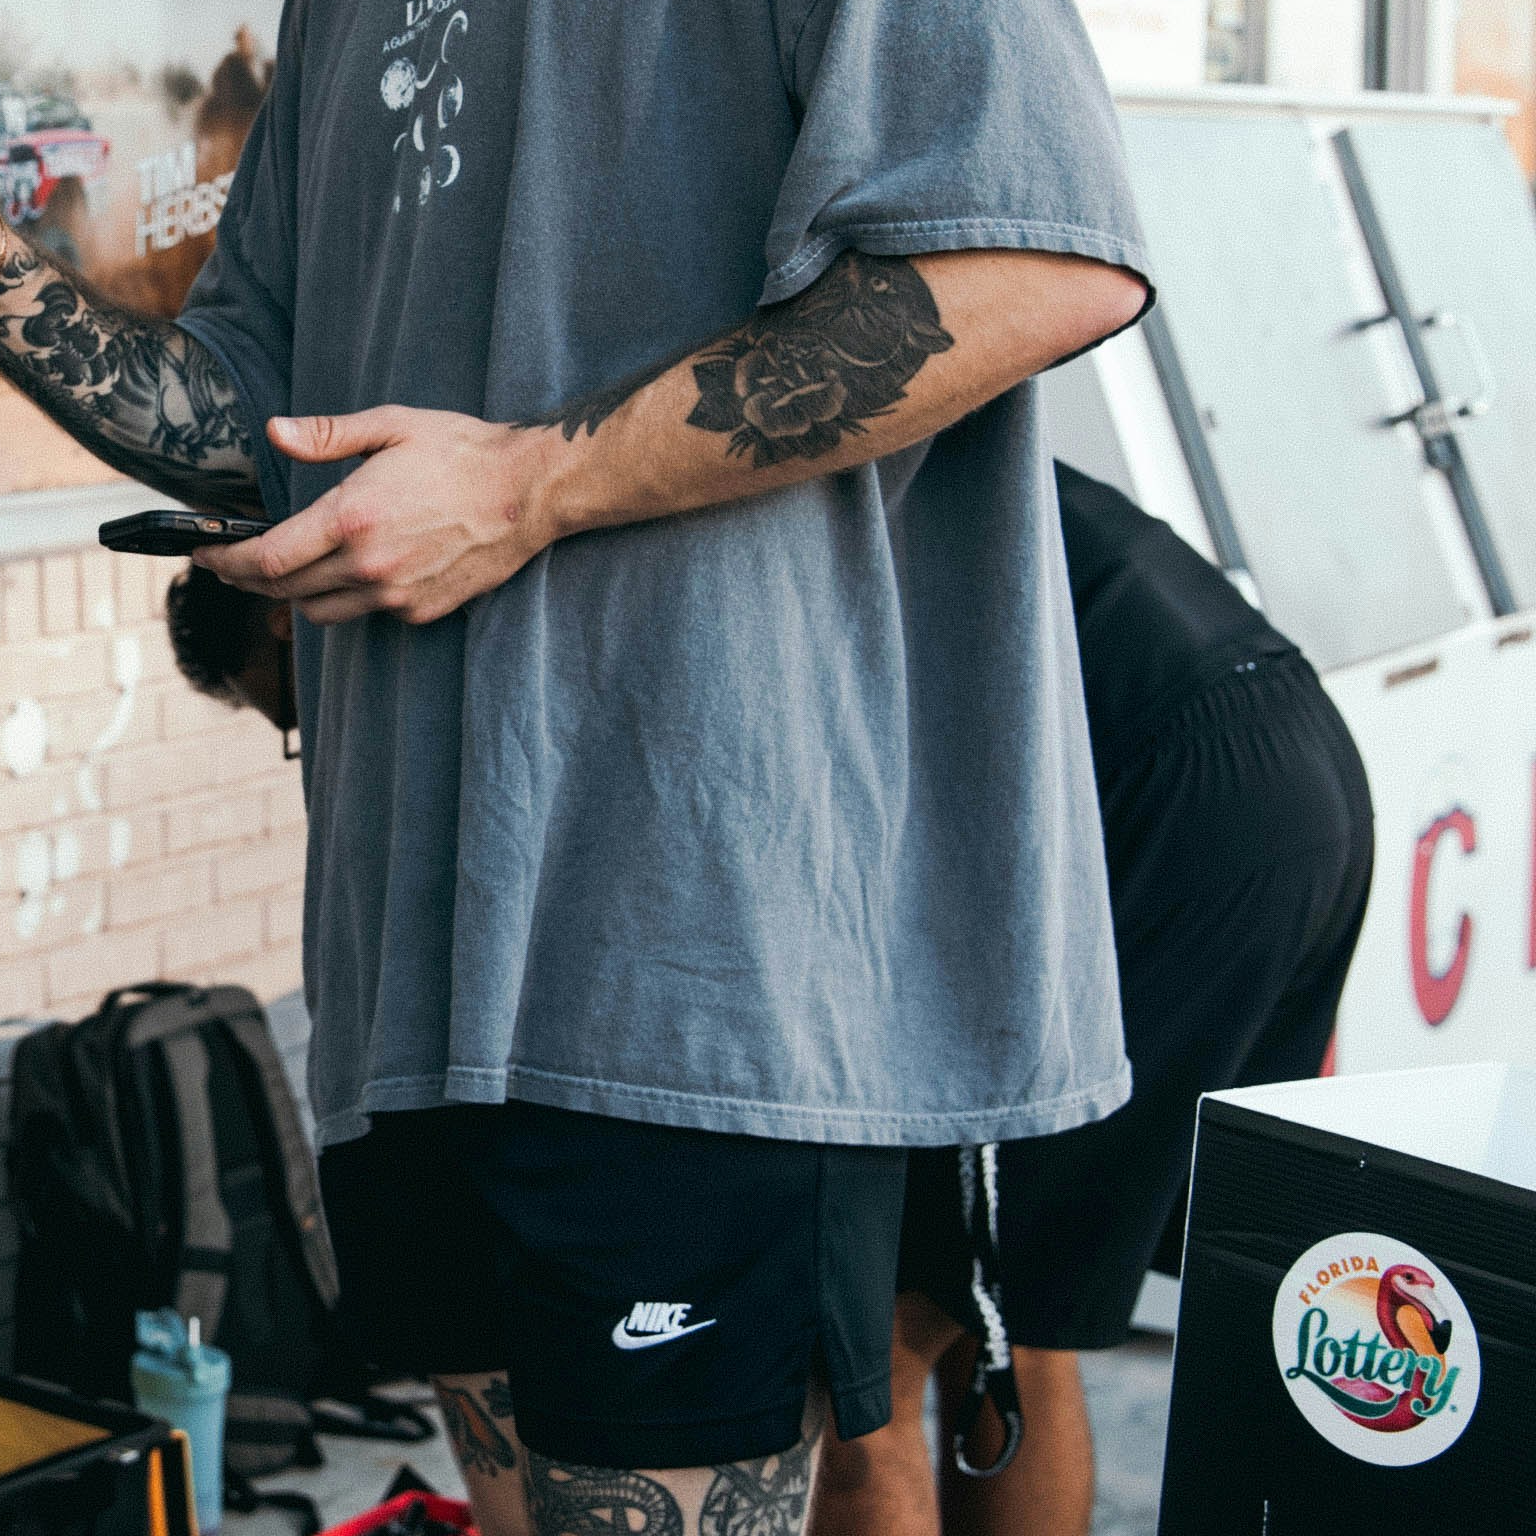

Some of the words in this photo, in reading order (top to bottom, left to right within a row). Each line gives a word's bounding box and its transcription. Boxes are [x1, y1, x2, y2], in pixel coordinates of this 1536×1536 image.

[1298, 1255, 1380, 1305] FLORIDA
[626, 1301, 692, 1333] NIKE
[1285, 1307, 1461, 1420] Lottery
